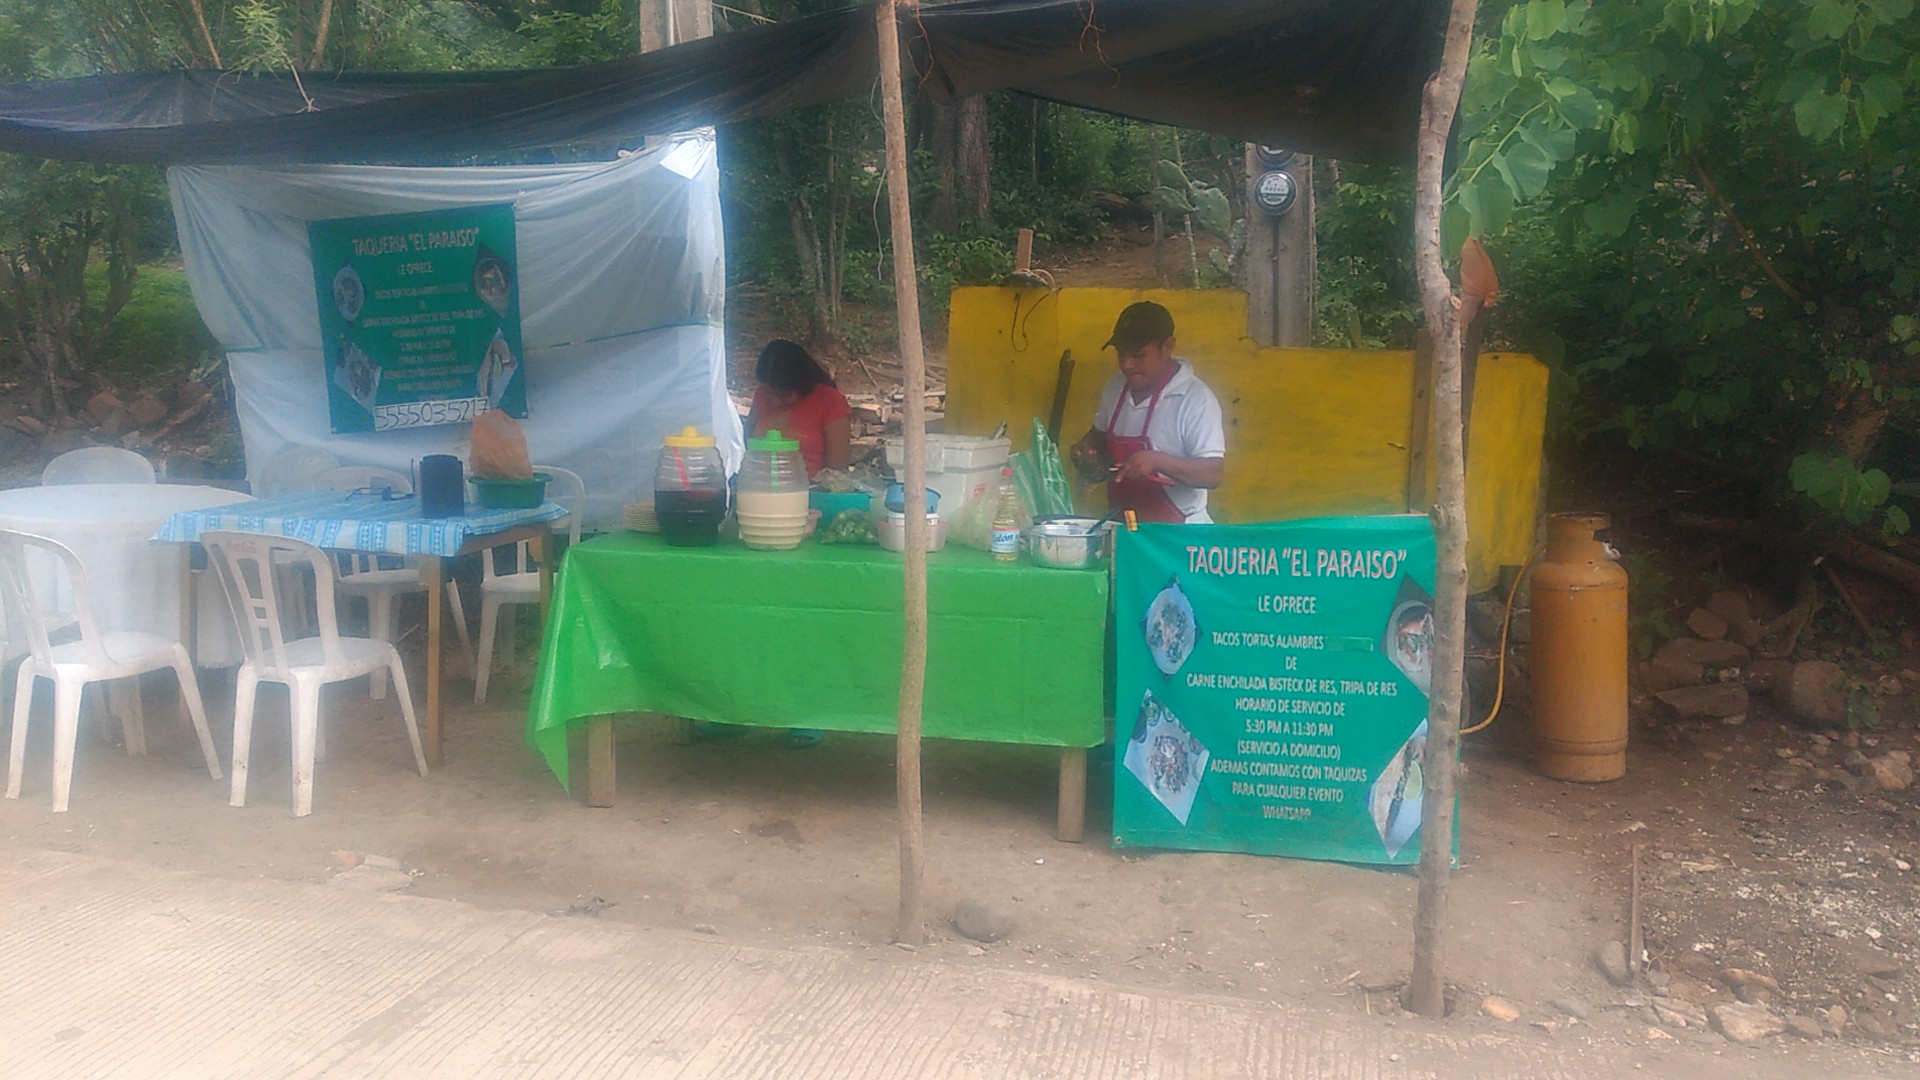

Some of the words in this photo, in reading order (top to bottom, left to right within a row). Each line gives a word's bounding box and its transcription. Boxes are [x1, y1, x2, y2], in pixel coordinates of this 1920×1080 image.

[352, 235, 407, 257] TAQUERIA
[407, 262, 433, 275] OFRECE
[1186, 546, 1279, 577] TAQUERIA
[1258, 595, 1270, 612] LE
[1273, 595, 1316, 614] OFRECE
[1212, 632, 1240, 647] TACOS
[1241, 632, 1275, 648] TORTAS
[1276, 634, 1324, 650] ALAMBRES
[1285, 656, 1297, 671] DE
[1186, 673, 1216, 689] CARNE
[1217, 674, 1267, 691] ENCHILADA
[1268, 676, 1304, 692] BISTECK
[1305, 677, 1317, 693] DE
[1319, 678, 1338, 696] RES,
[1340, 679, 1365, 695] TRIPA
[1366, 680, 1379, 695] DE
[1380, 681, 1397, 696] RES
[1235, 698, 1276, 713] HORARIO
[1277, 698, 1289, 713] DE
[1291, 699, 1332, 715] SERVICIO
[1333, 701, 1346, 716] DE
[1245, 719, 1265, 734] 5:30
[1267, 720, 1281, 735] PM
[1283, 720, 1291, 735] A
[1292, 721, 1316, 736] 11:30
[1318, 722, 1334, 737] PM
[1237, 739, 1280, 757] (SERVICIO
[1281, 742, 1288, 756] A
[1290, 742, 1341, 761] DOMICILIO)
[1210, 758, 1249, 774] ADEMAS
[1250, 760, 1300, 777] CONTAMOS
[1302, 763, 1322, 779] CON
[1323, 765, 1367, 782] TAQUIZAS
[1232, 781, 1254, 796] PARA
[1256, 783, 1306, 801] CUALQUIER
[1308, 786, 1344, 803] EVENTO
